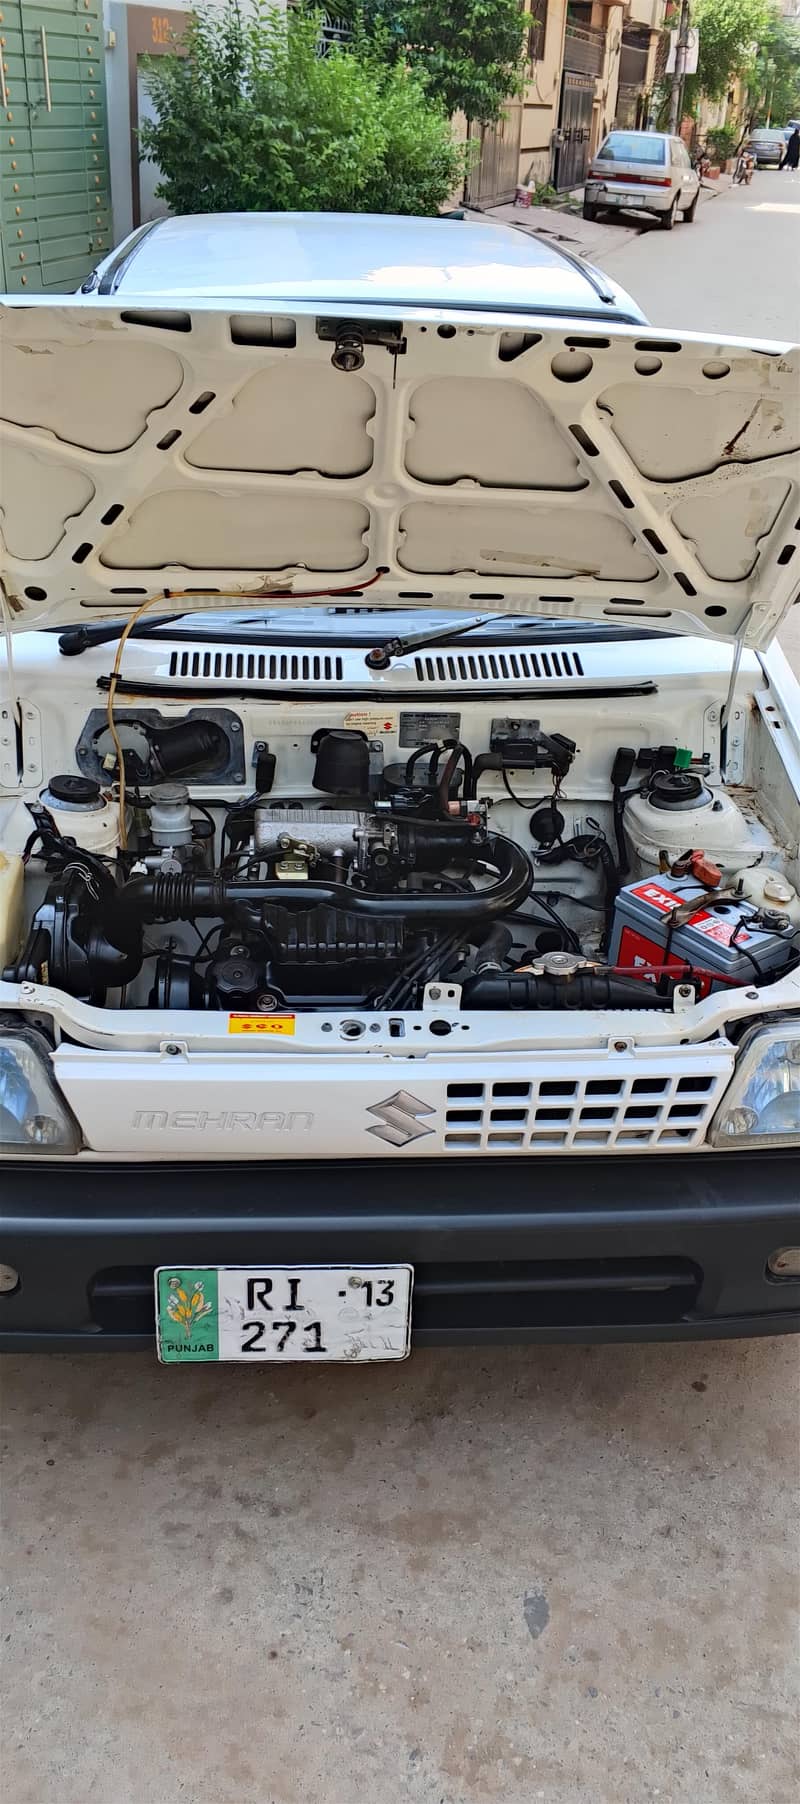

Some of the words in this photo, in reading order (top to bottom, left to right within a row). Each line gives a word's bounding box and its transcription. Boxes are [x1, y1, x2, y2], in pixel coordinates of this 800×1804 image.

[644, 889, 682, 910] EXI
[131, 1110, 316, 1131] MEHRAN
[247, 1278, 305, 1311] RI
[241, 1321, 328, 1352] 271
[167, 1343, 214, 1353] PUNJAB
